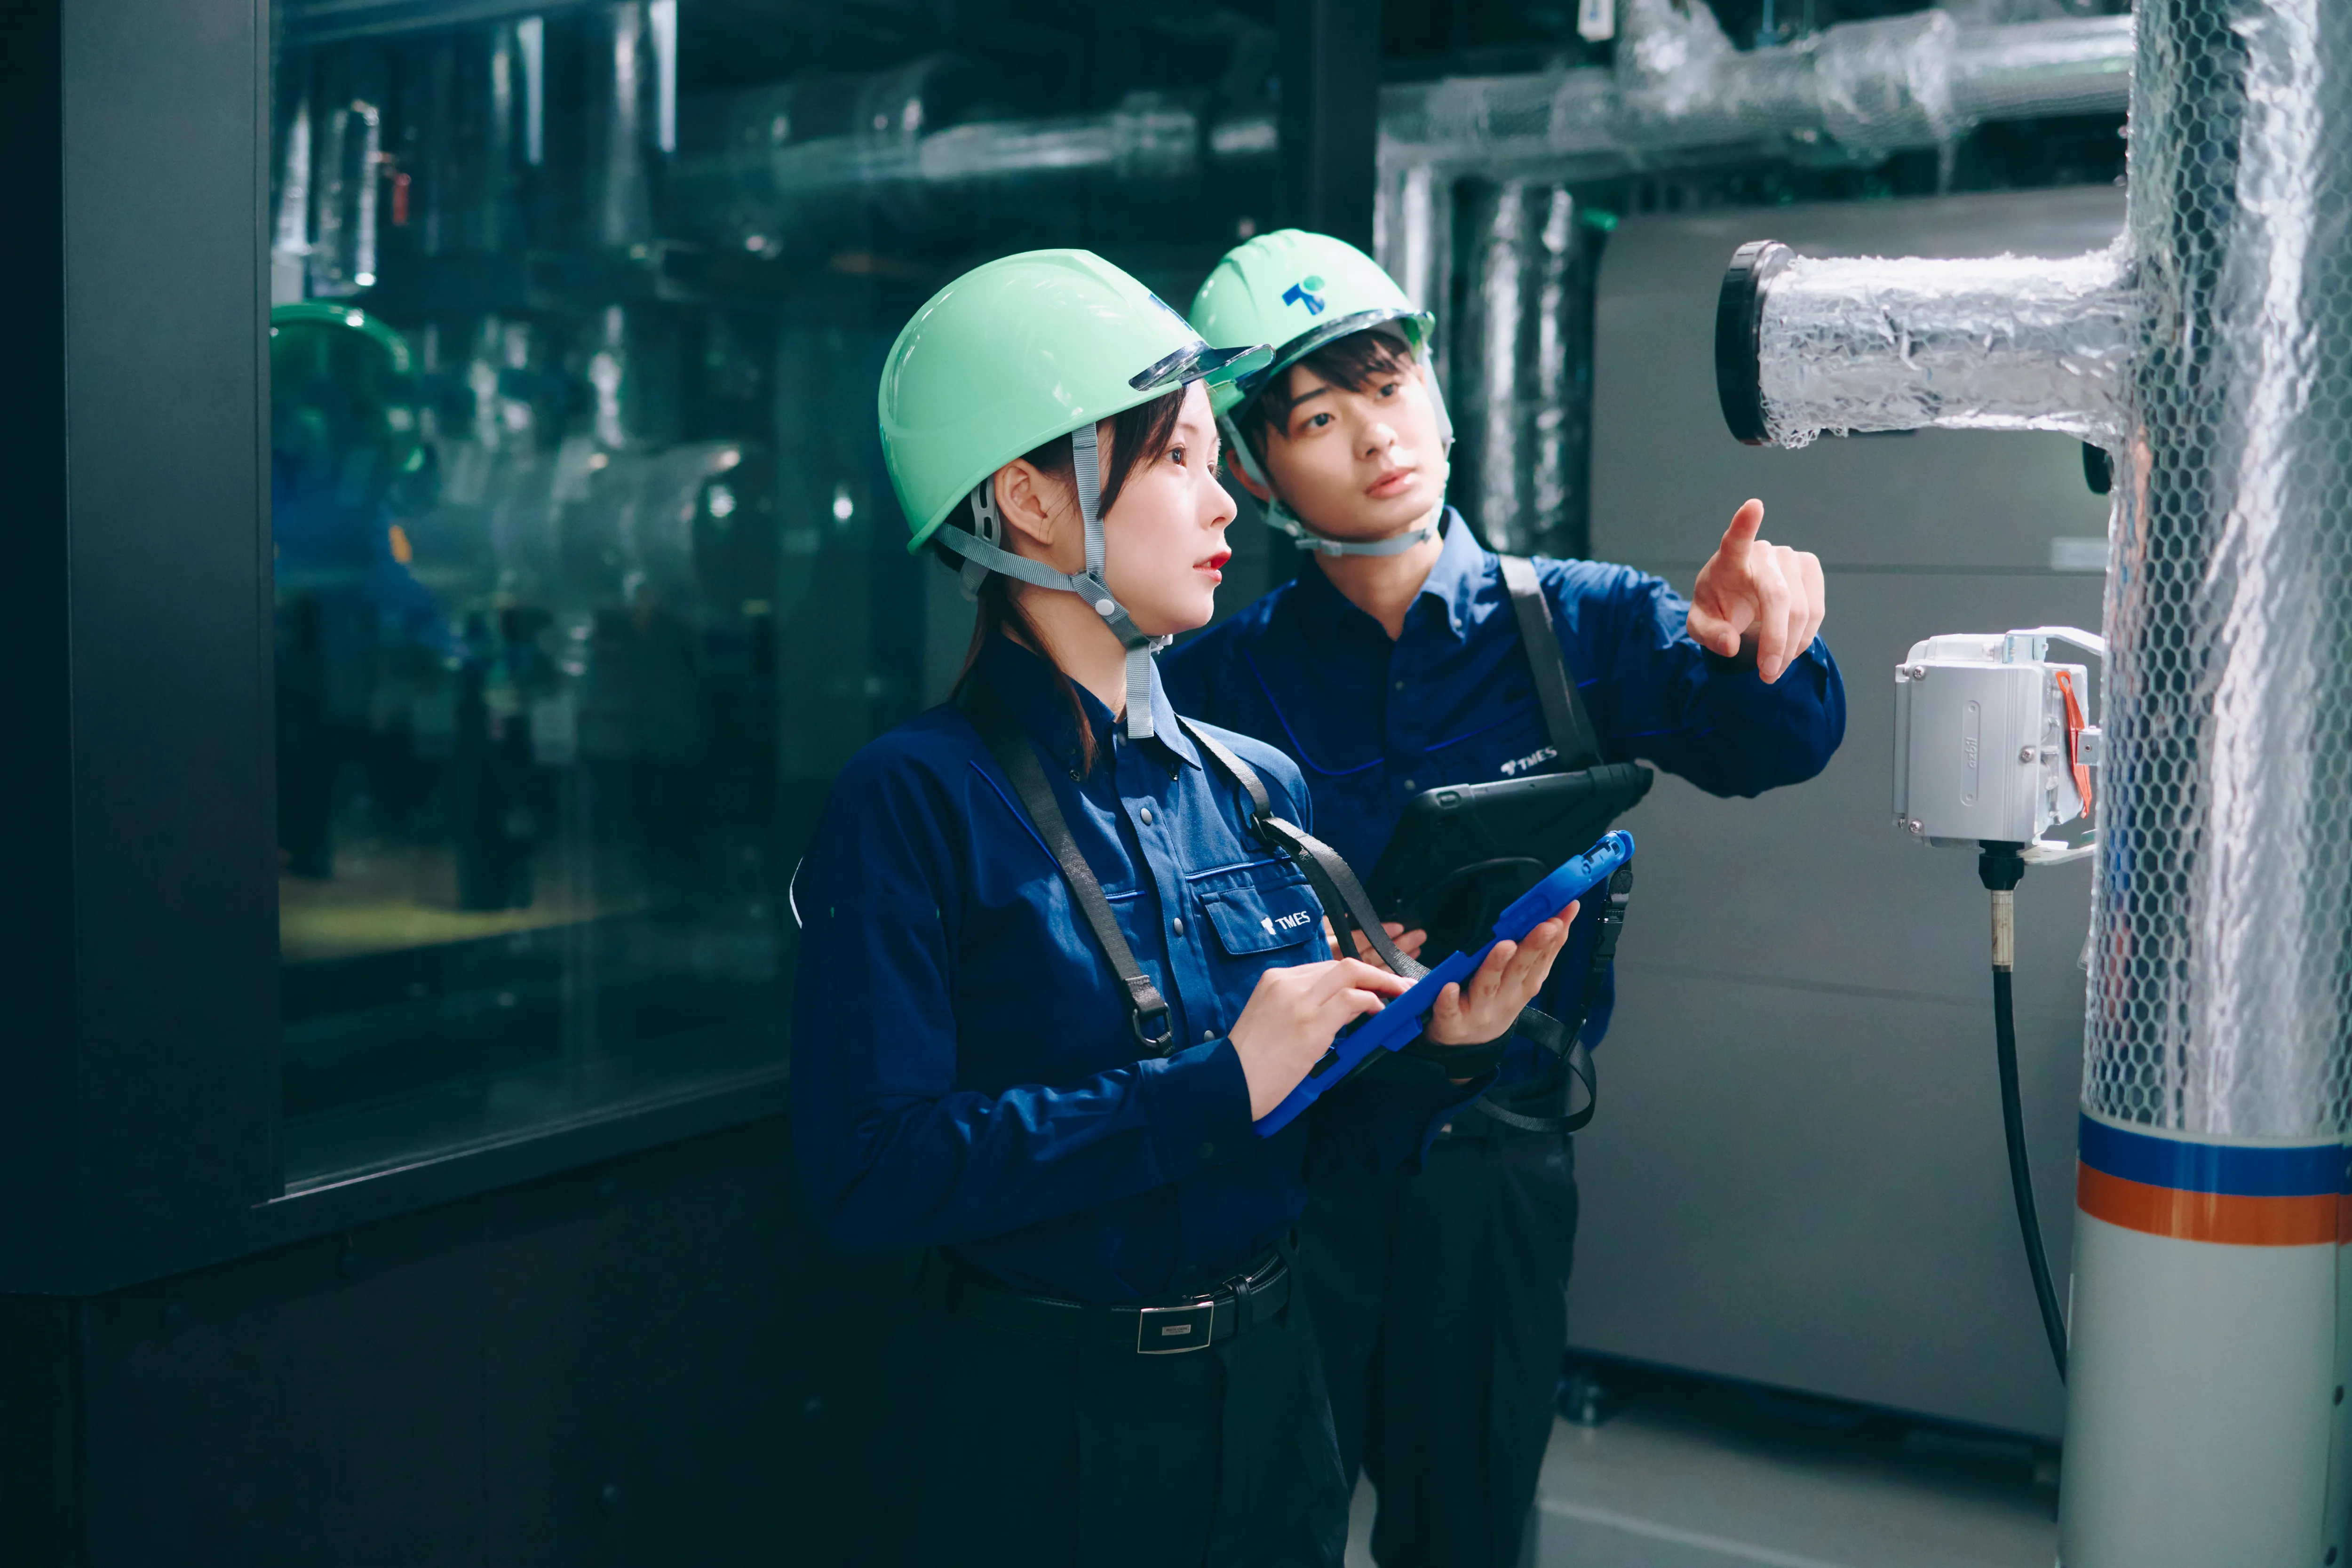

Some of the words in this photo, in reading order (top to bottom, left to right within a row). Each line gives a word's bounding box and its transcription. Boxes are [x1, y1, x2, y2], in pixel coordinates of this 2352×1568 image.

[1517, 746, 1557, 770] TMES
[1965, 737, 1977, 769] azbil
[1275, 911, 1311, 930] TMES
